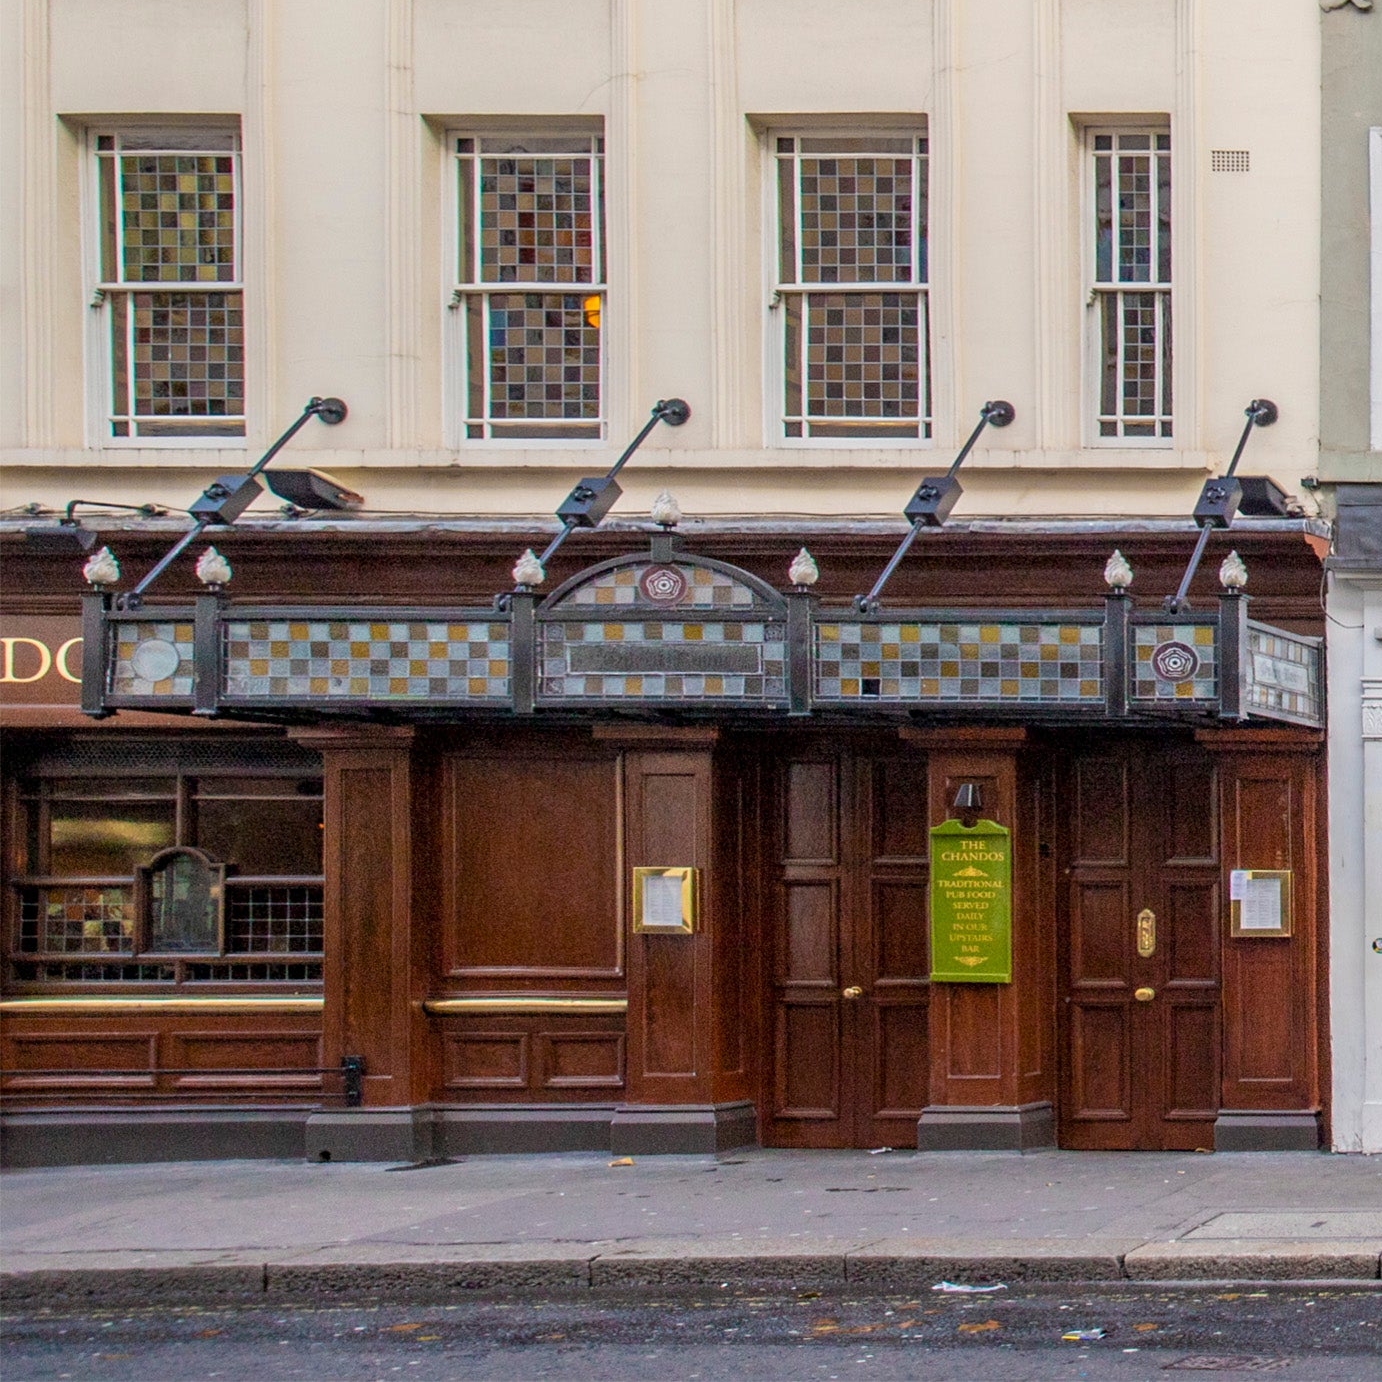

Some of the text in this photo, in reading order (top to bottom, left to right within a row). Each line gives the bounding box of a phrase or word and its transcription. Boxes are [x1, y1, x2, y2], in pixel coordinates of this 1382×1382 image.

[960, 840, 987, 850] THE
[941, 851, 1005, 861] CHANDOS
[937, 880, 1004, 888] TRADITIONAL
[945, 891, 996, 899] PUB FOOD
[952, 901, 990, 909] SERVED
